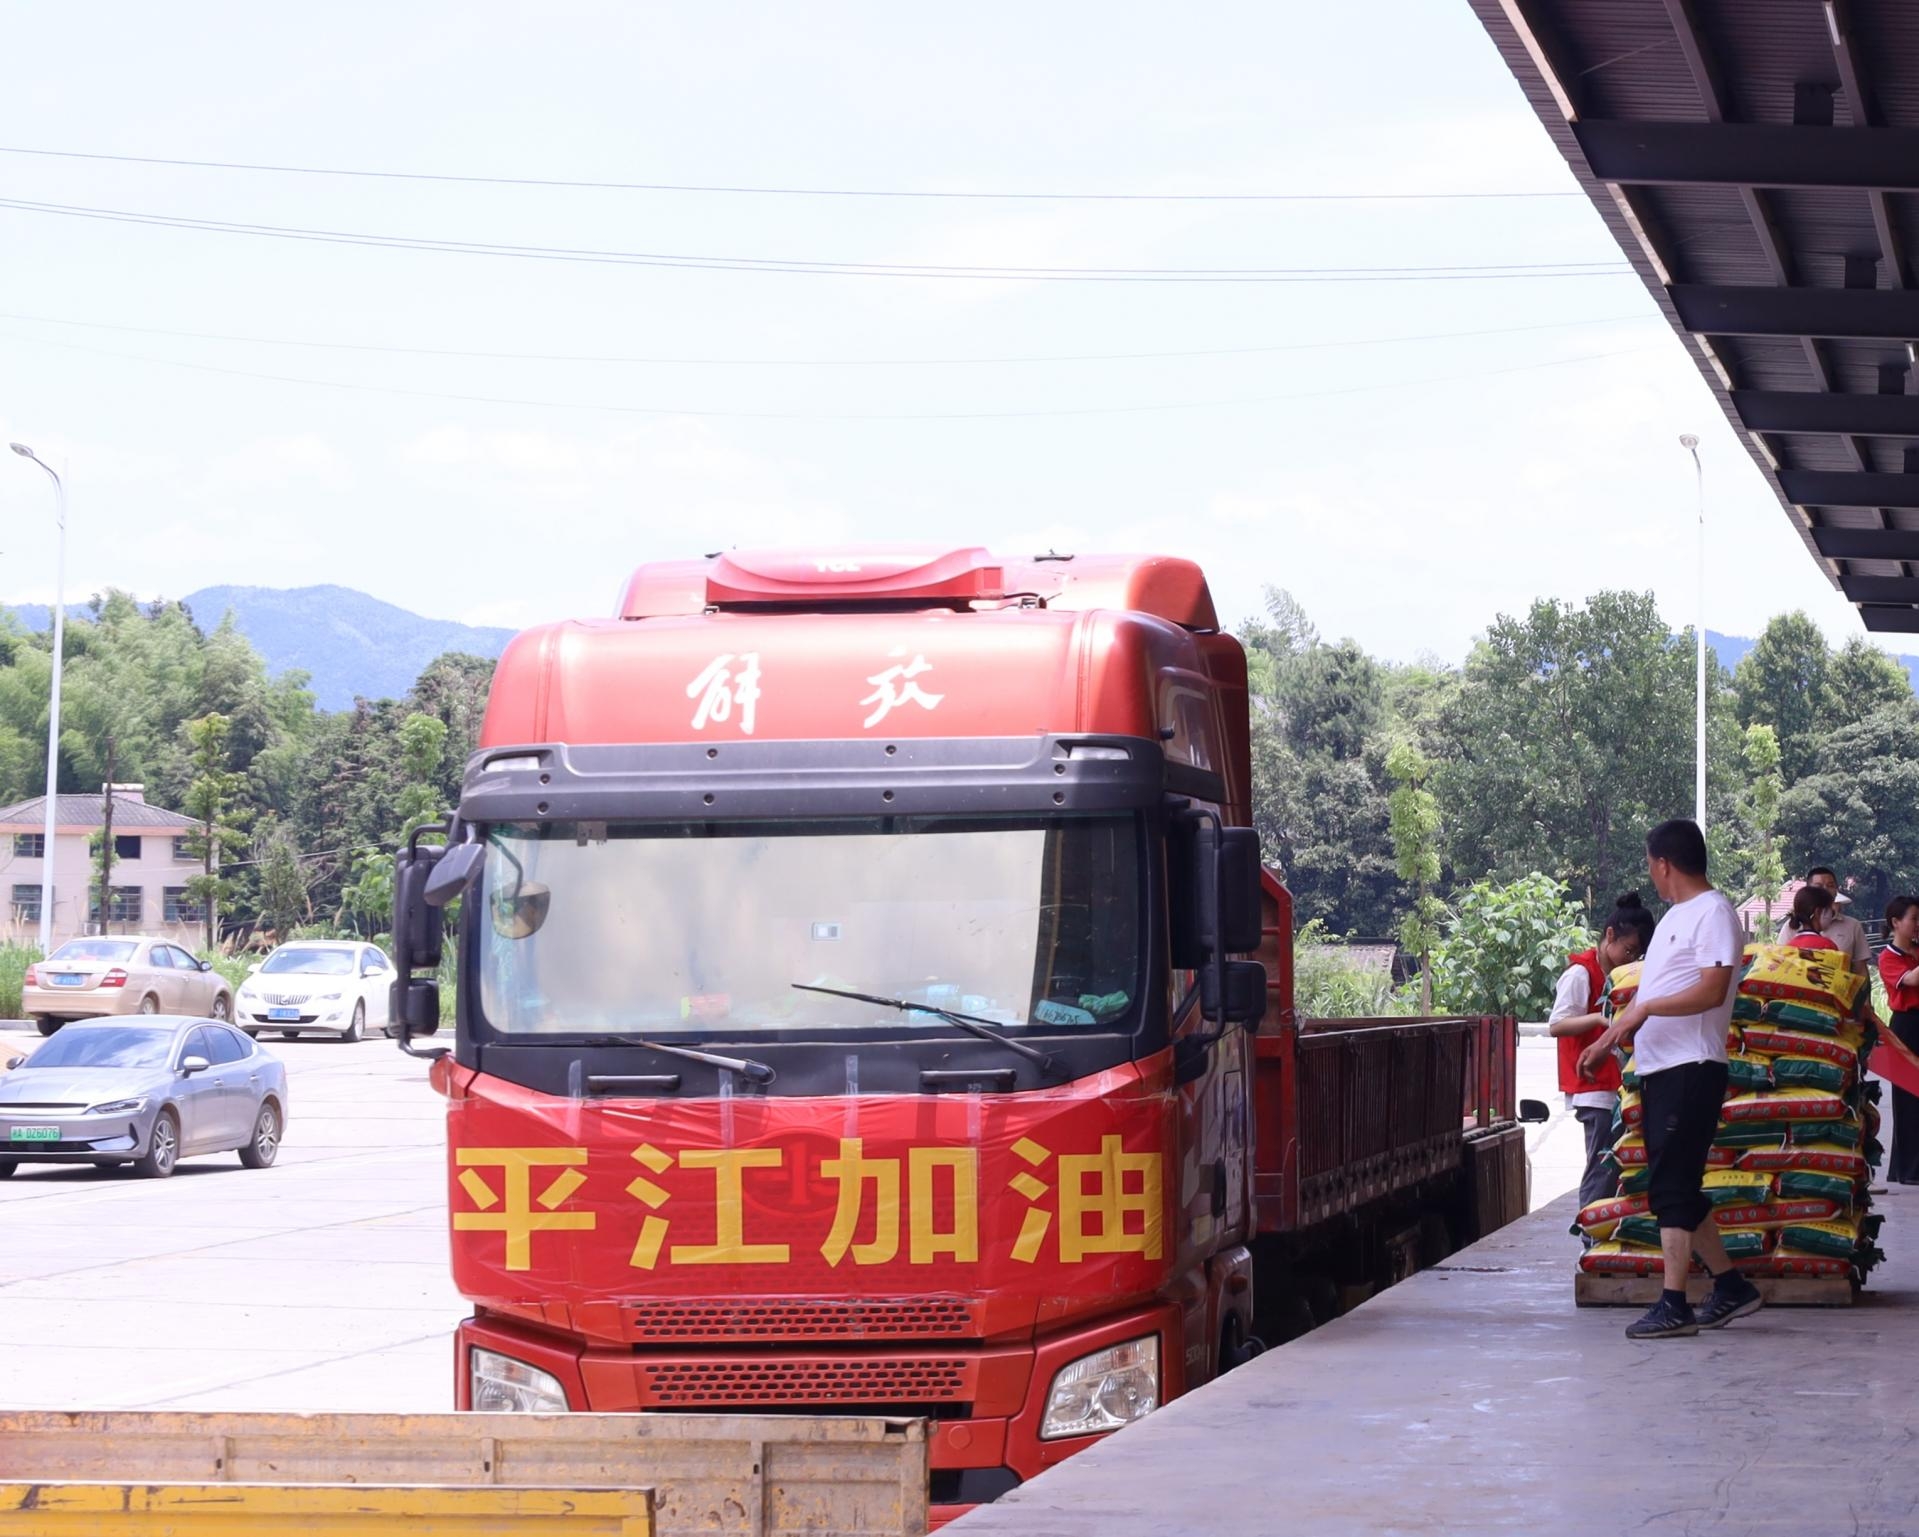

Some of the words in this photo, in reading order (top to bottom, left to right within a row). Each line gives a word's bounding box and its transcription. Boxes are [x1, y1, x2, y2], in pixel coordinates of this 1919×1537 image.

[686, 647, 945, 735] 解放
[453, 1135, 1163, 1271] 平江加油
